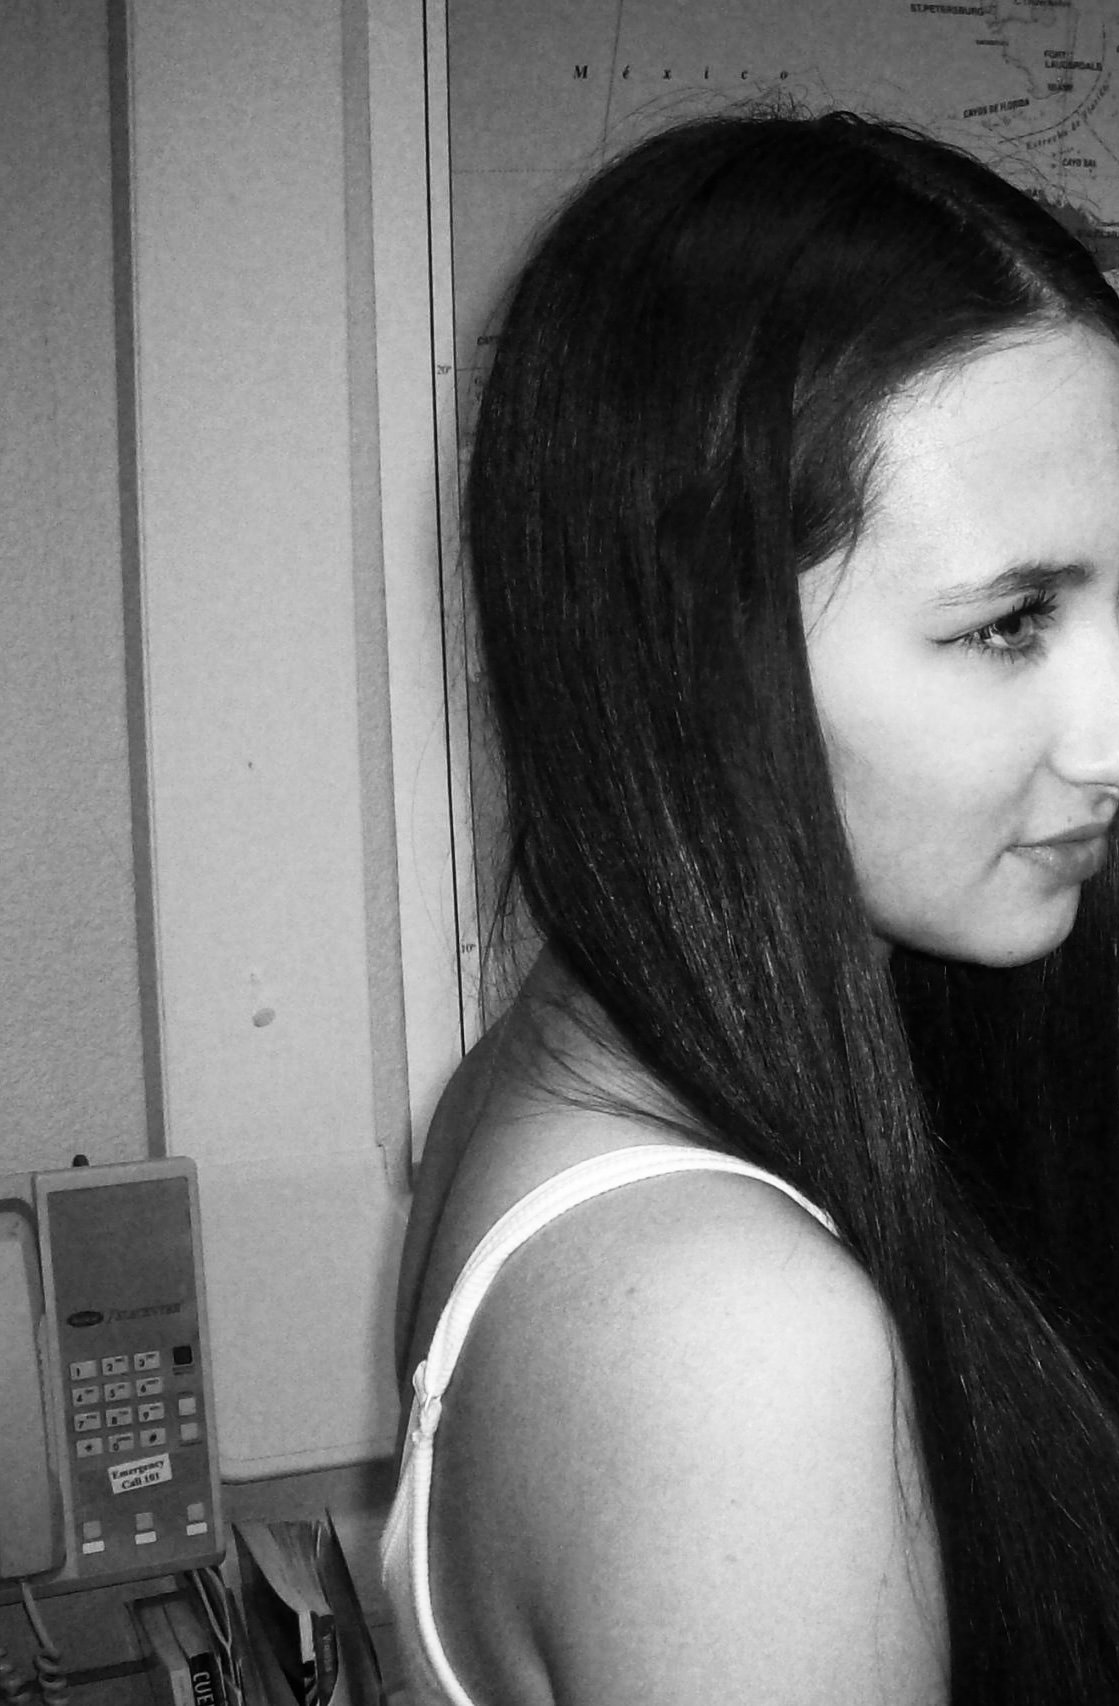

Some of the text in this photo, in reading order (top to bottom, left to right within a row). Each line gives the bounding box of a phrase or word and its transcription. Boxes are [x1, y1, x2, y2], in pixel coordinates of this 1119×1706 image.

[112, 1460, 165, 1480] Emergency
[121, 1472, 160, 1490] Call 101
[193, 1671, 215, 1706] CUE
